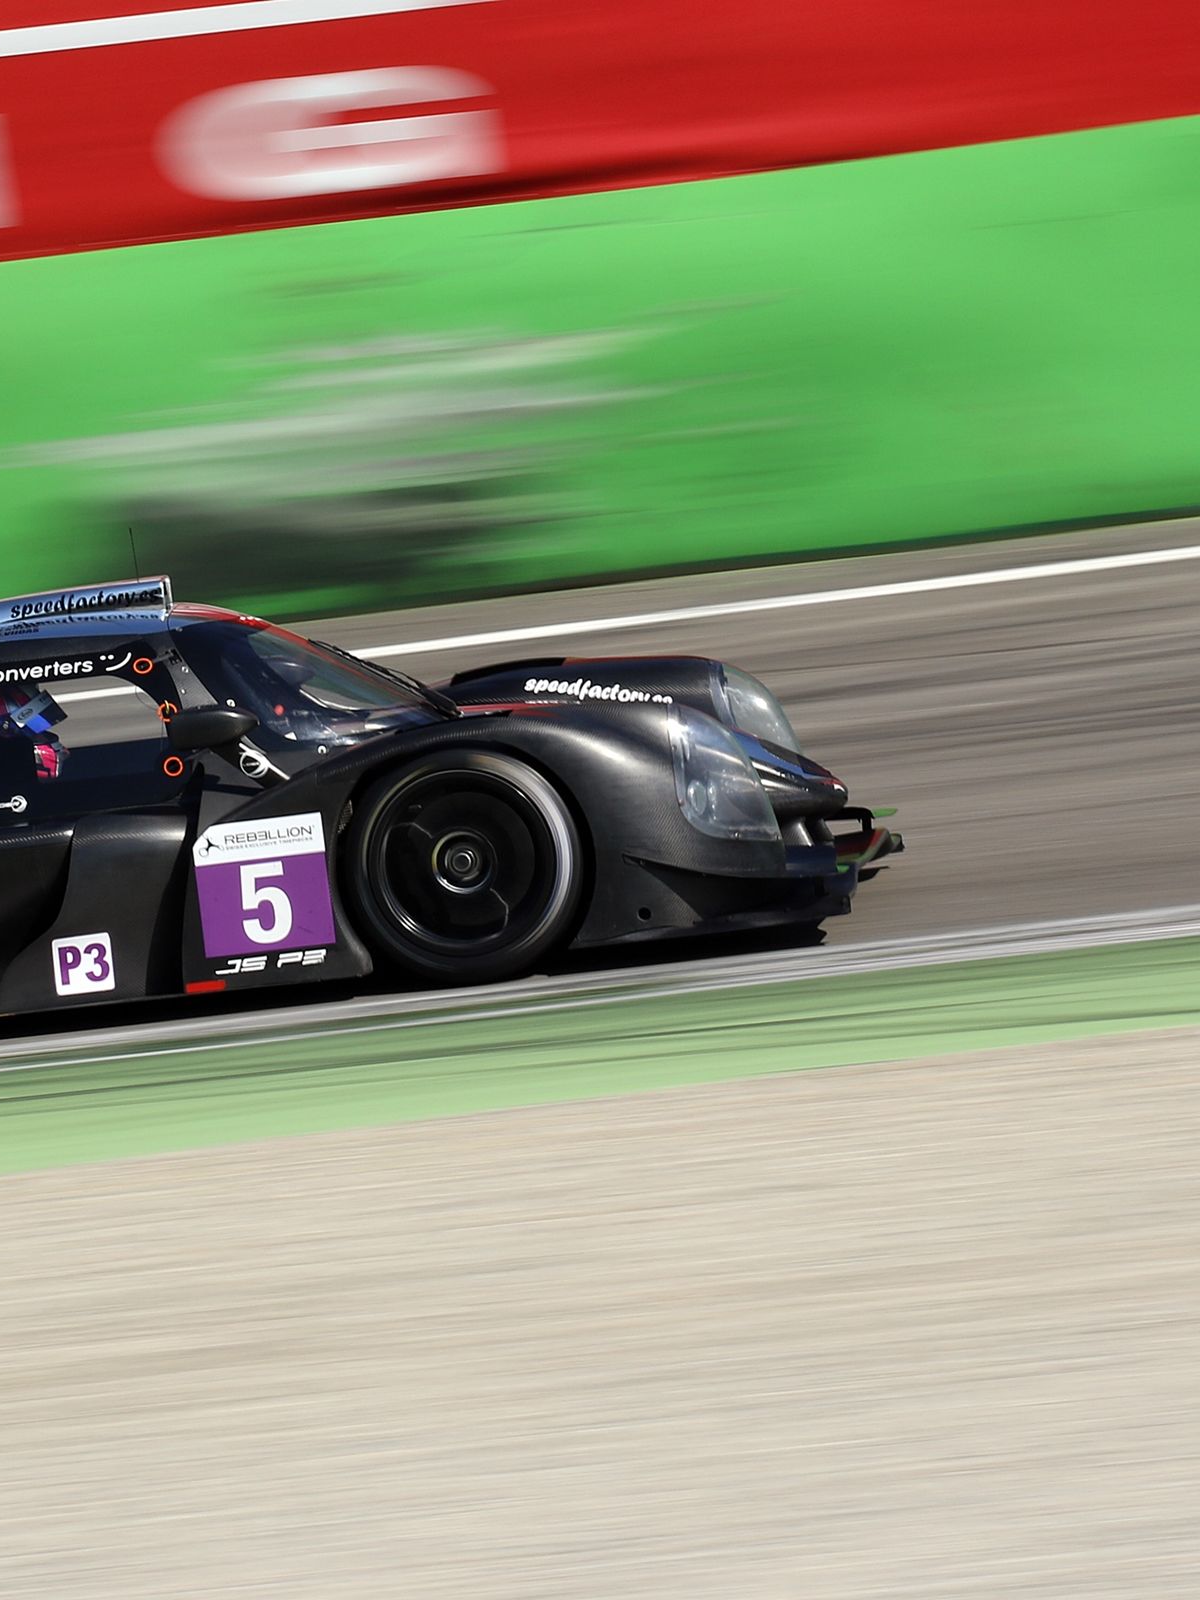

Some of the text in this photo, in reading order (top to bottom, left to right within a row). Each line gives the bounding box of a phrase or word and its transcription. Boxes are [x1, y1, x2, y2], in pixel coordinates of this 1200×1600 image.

[224, 826, 313, 845] REBELLION
[240, 861, 292, 944] 5
[58, 943, 110, 985] P3
[215, 956, 267, 975] JS
